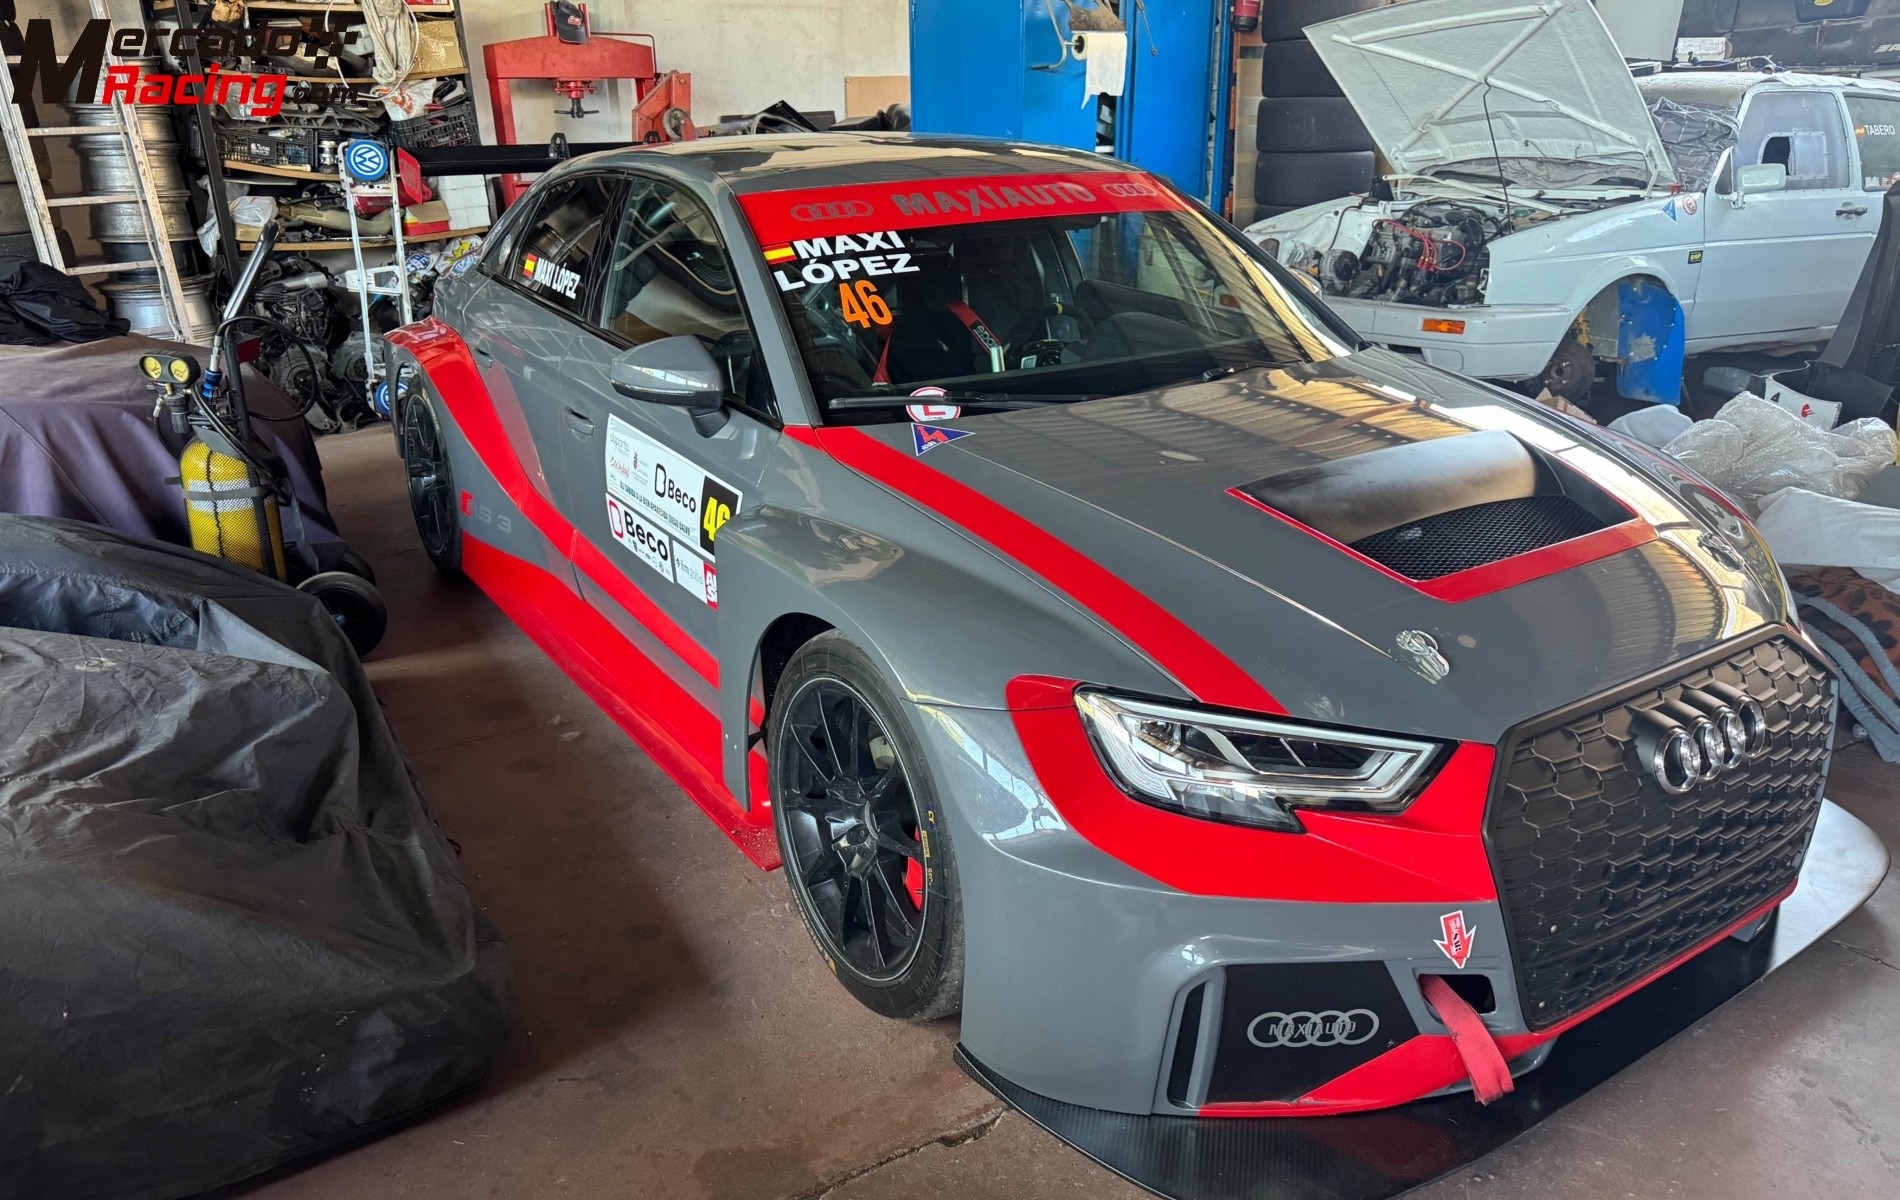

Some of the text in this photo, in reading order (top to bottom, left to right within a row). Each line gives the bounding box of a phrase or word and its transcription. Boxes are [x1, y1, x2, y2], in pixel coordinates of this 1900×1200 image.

[1864, 125, 1896, 136] TABERO
[793, 230, 905, 259] MAXI
[535, 257, 581, 300] MAXI LÓPEZ
[773, 253, 920, 291] LÓPEZ
[838, 279, 893, 329] 46
[667, 478, 697, 513] Beco
[497, 513, 512, 534] 3
[623, 510, 669, 561] Beco
